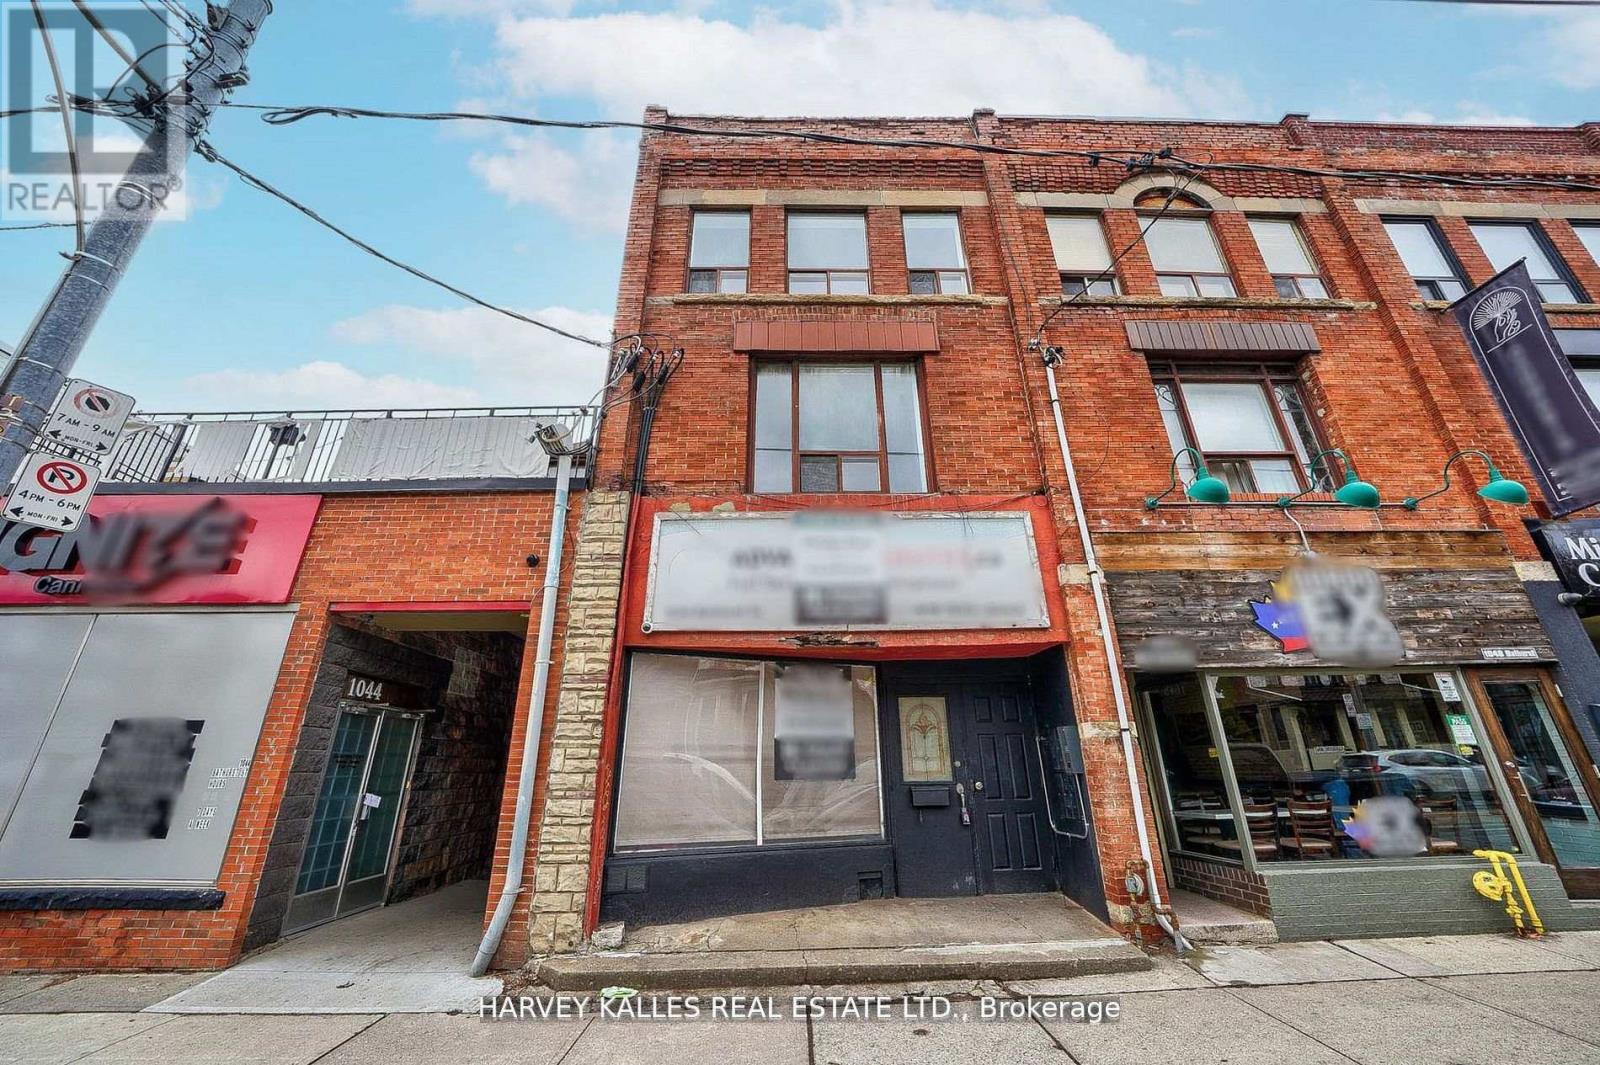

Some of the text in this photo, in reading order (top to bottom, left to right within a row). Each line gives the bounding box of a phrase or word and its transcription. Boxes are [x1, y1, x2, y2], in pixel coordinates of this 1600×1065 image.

[56, 412, 66, 421] 7
[66, 417, 80, 428] AM
[92, 424, 100, 433] 9
[101, 429, 116, 438] AM
[18, 490, 29, 499] 4
[30, 493, 44, 503] PM
[57, 499, 66, 508] 6
[66, 502, 81, 512] PM
[348, 677, 382, 700] 1044
